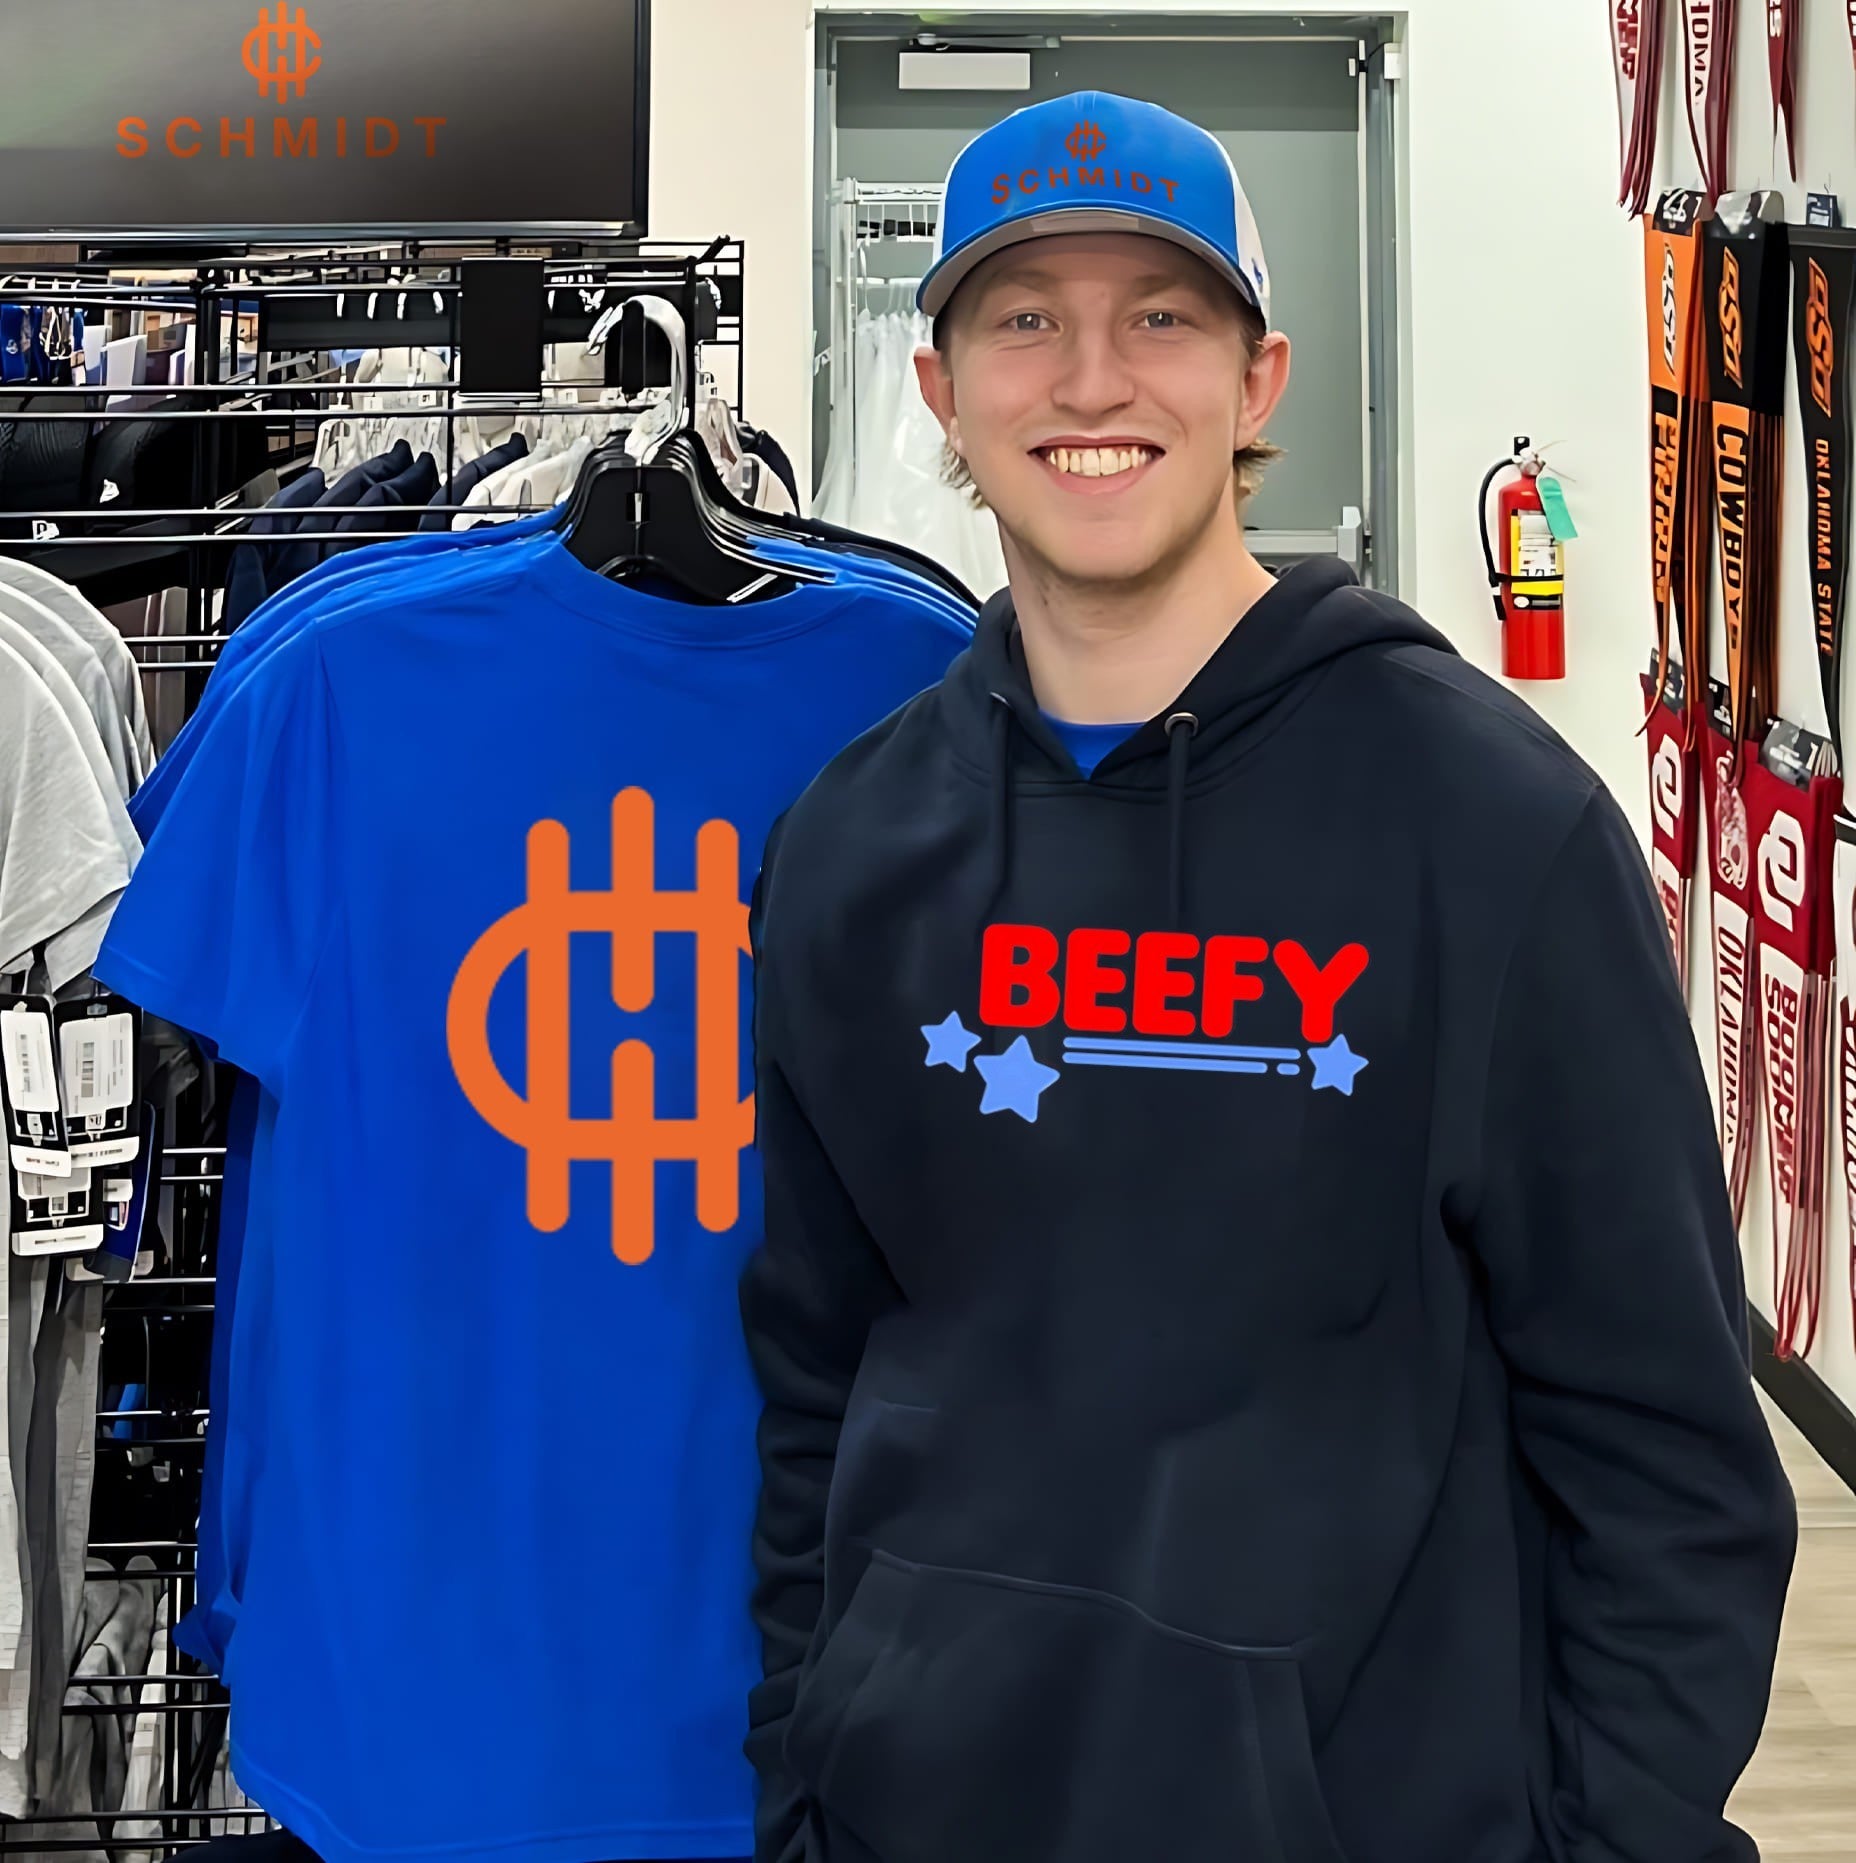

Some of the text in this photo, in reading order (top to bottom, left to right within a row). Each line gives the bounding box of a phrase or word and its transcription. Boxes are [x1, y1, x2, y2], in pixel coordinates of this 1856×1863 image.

[116, 116, 448, 159] SCHMIDT
[991, 167, 1180, 205] SCHMIDT
[1815, 439, 1832, 570] OKLAHOMA
[979, 923, 1369, 1043] BEEFY
[1719, 925, 1745, 1145] OKLAHOMA
